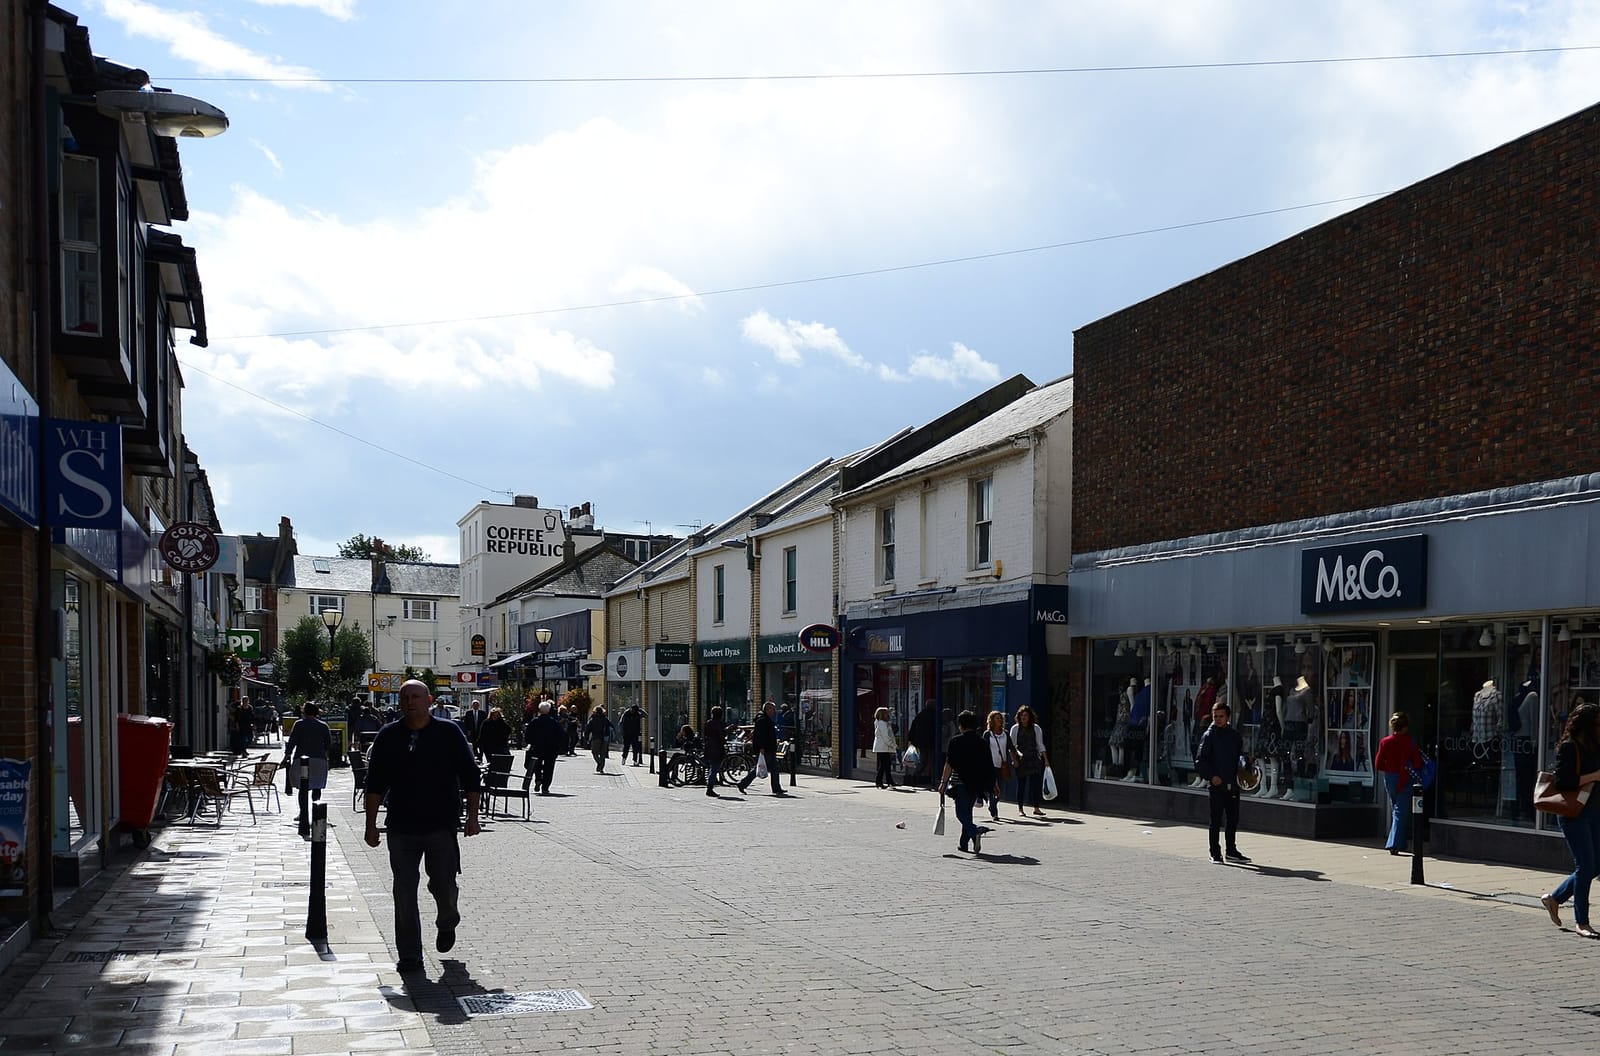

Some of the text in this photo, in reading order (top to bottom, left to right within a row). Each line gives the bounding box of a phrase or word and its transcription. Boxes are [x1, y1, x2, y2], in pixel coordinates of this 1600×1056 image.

[56, 427, 108, 450] WH
[58, 449, 112, 519] S
[171, 527, 208, 542] COSTA
[487, 525, 544, 542] COFFEE
[487, 539, 563, 557] REPUBLIC
[168, 551, 211, 568] COFFEE
[1315, 549, 1402, 604] M&Co.
[768, 642, 796, 655] Robert
[809, 637, 831, 648] HILL
[703, 647, 741, 658] Robert Dyas
[1491, 737, 1536, 754] COLLECT
